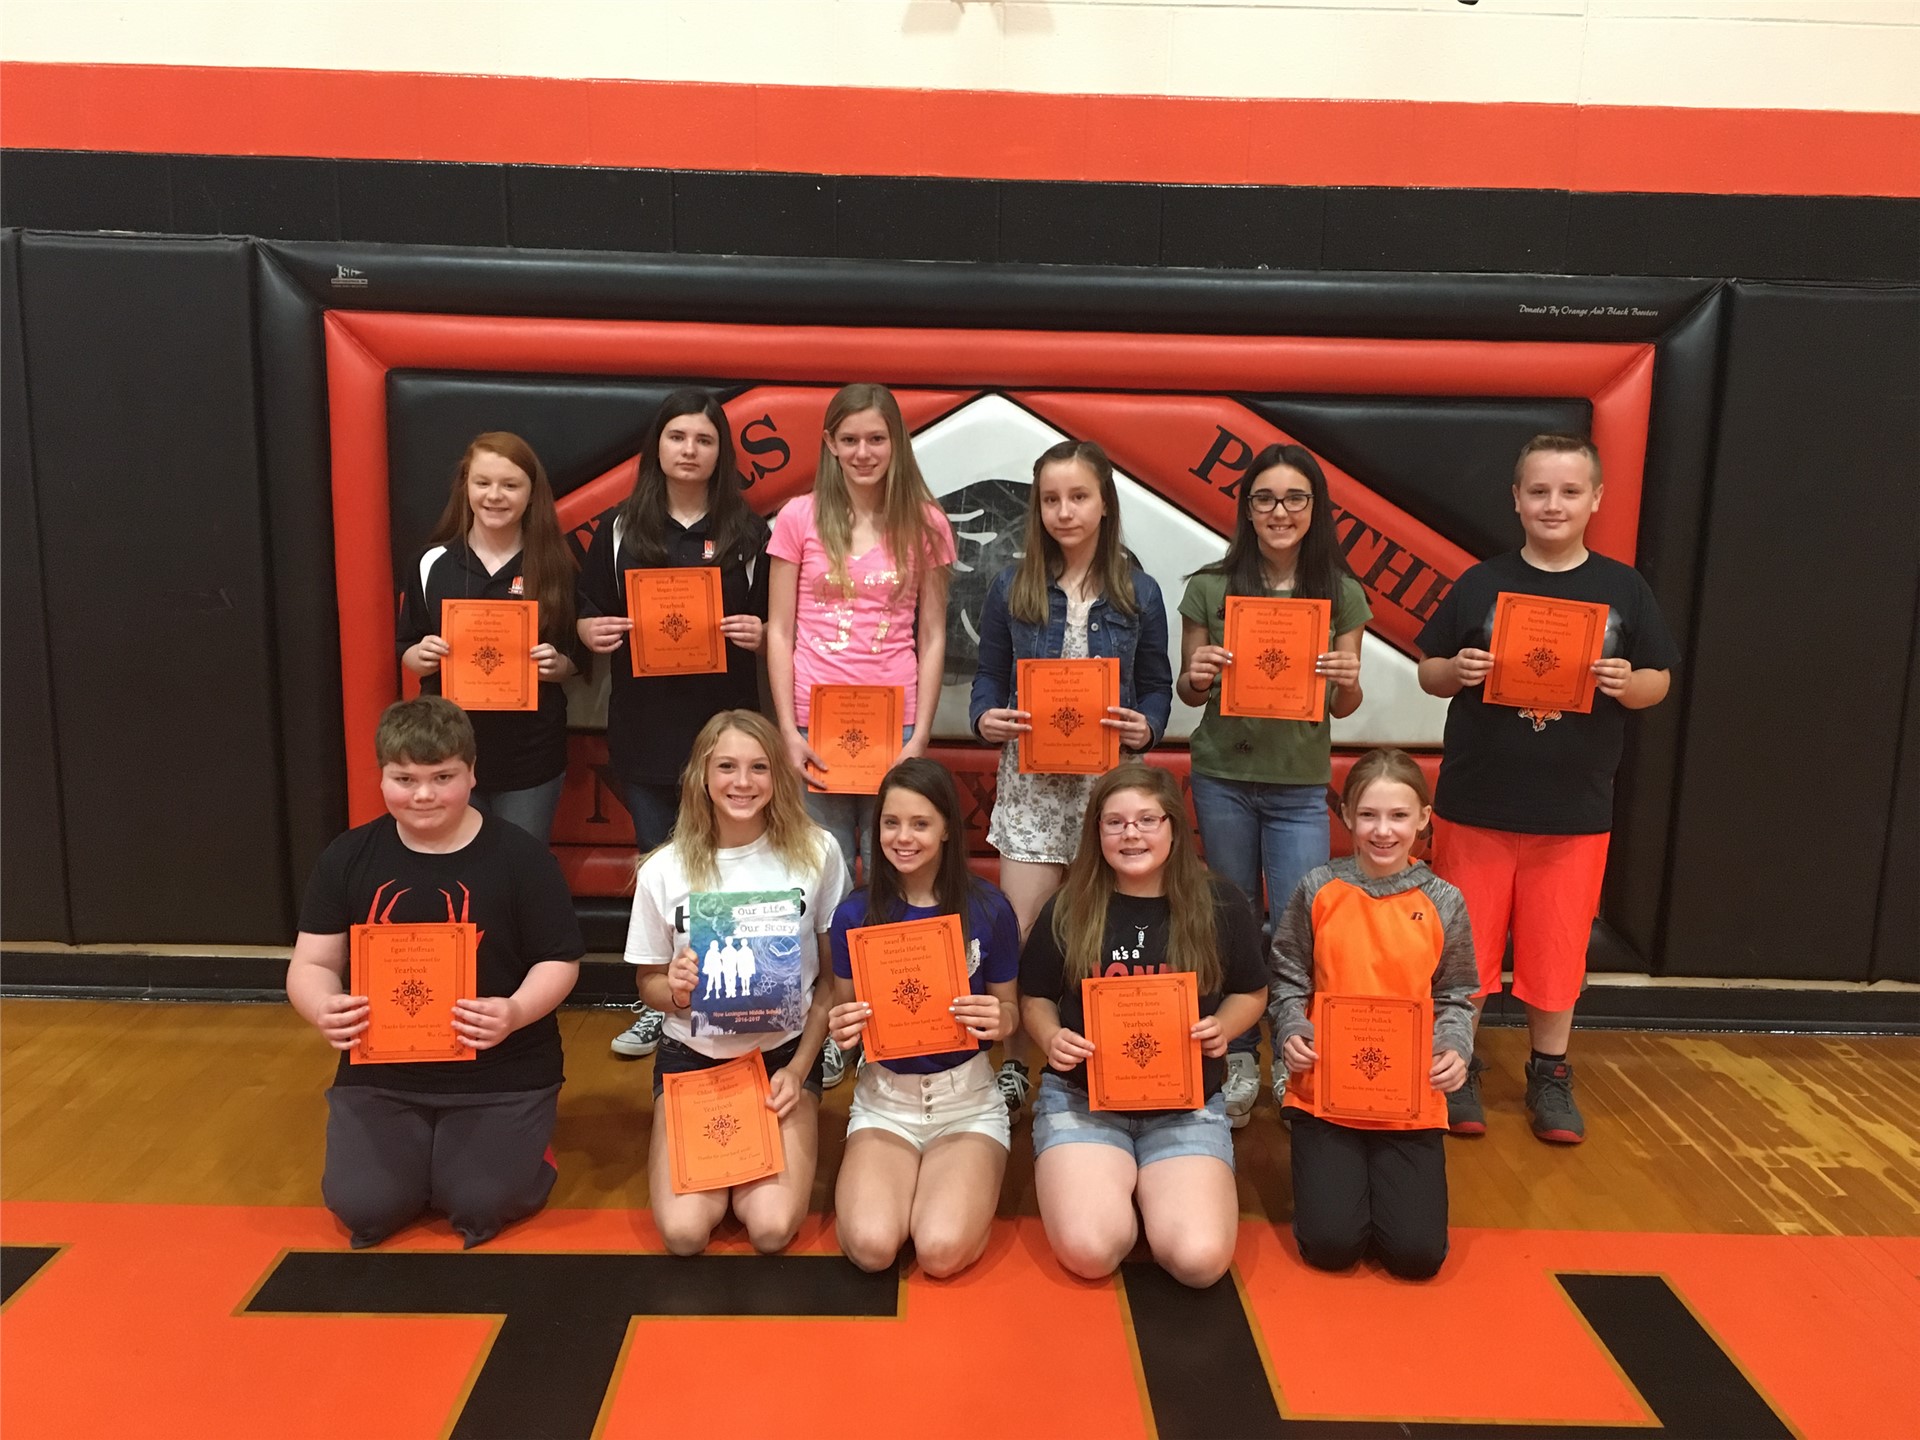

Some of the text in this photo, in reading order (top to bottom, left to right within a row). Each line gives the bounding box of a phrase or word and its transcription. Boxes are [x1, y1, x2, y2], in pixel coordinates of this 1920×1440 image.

[1519, 304, 1547, 314] Donated
[1548, 306, 1559, 317] By
[1561, 306, 1588, 317] Orange
[1588, 306, 1605, 317] And
[1606, 306, 1629, 316] Black
[1528, 635, 1558, 644] Yearbook
[738, 907, 757, 915] Our
[740, 924, 759, 932] Our
[1112, 946, 1140, 960] It's a
[394, 966, 427, 974] Yearbook
[890, 964, 921, 975] Yearbook
[1122, 1020, 1154, 1028] Yearbook
[1353, 1034, 1385, 1043] Yearbook
[703, 1101, 733, 1113] Yearbook
